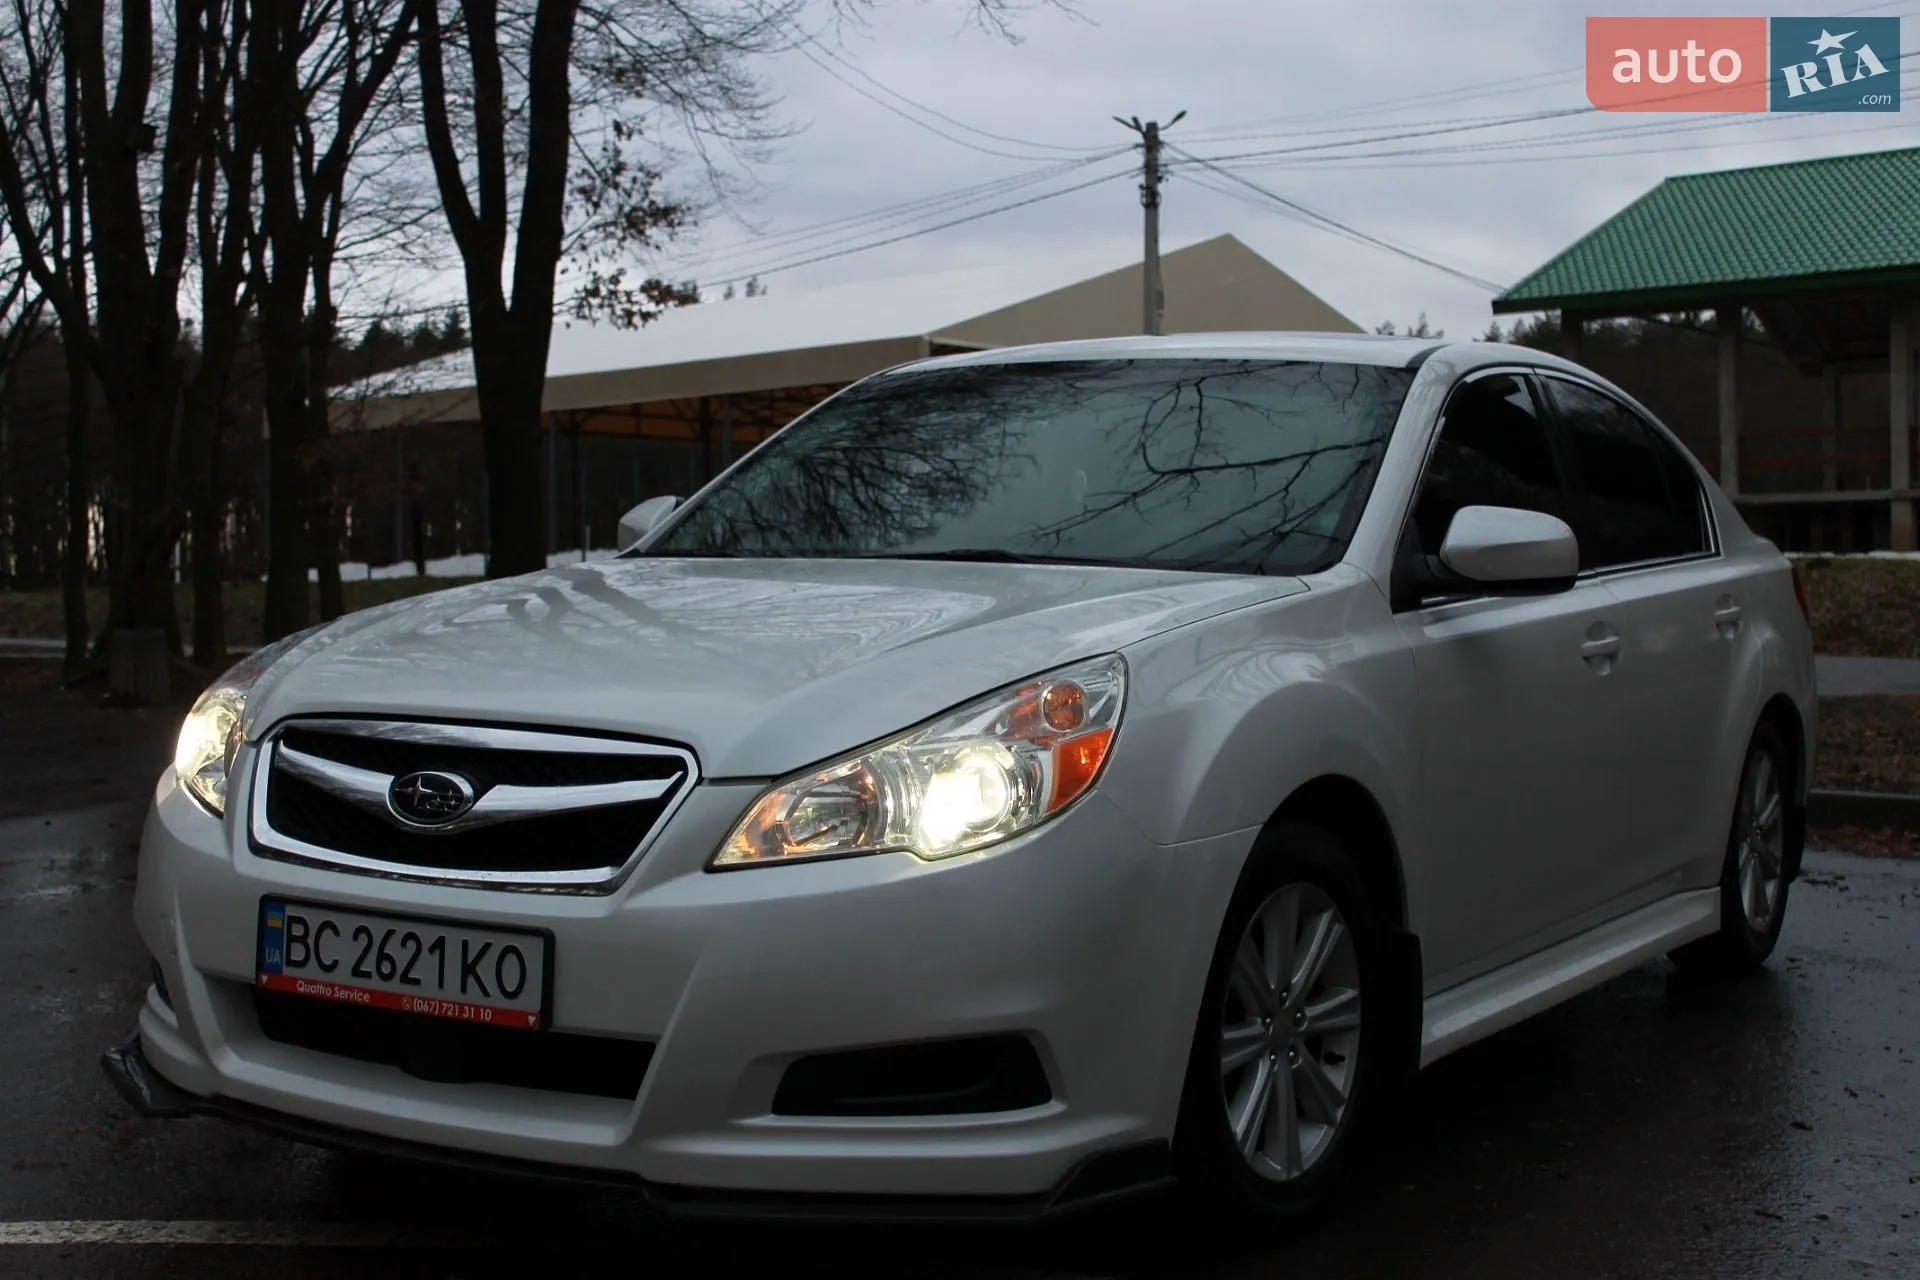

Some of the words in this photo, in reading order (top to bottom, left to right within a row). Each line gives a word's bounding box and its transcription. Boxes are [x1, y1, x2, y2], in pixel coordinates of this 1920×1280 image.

[265, 946, 281, 965] UA
[296, 980, 333, 997] Quattro
[334, 986, 370, 1003] Service
[413, 997, 440, 1017] (067)
[441, 1002, 459, 1017] 721
[463, 1006, 475, 1019] 31
[479, 1008, 492, 1022] 10
